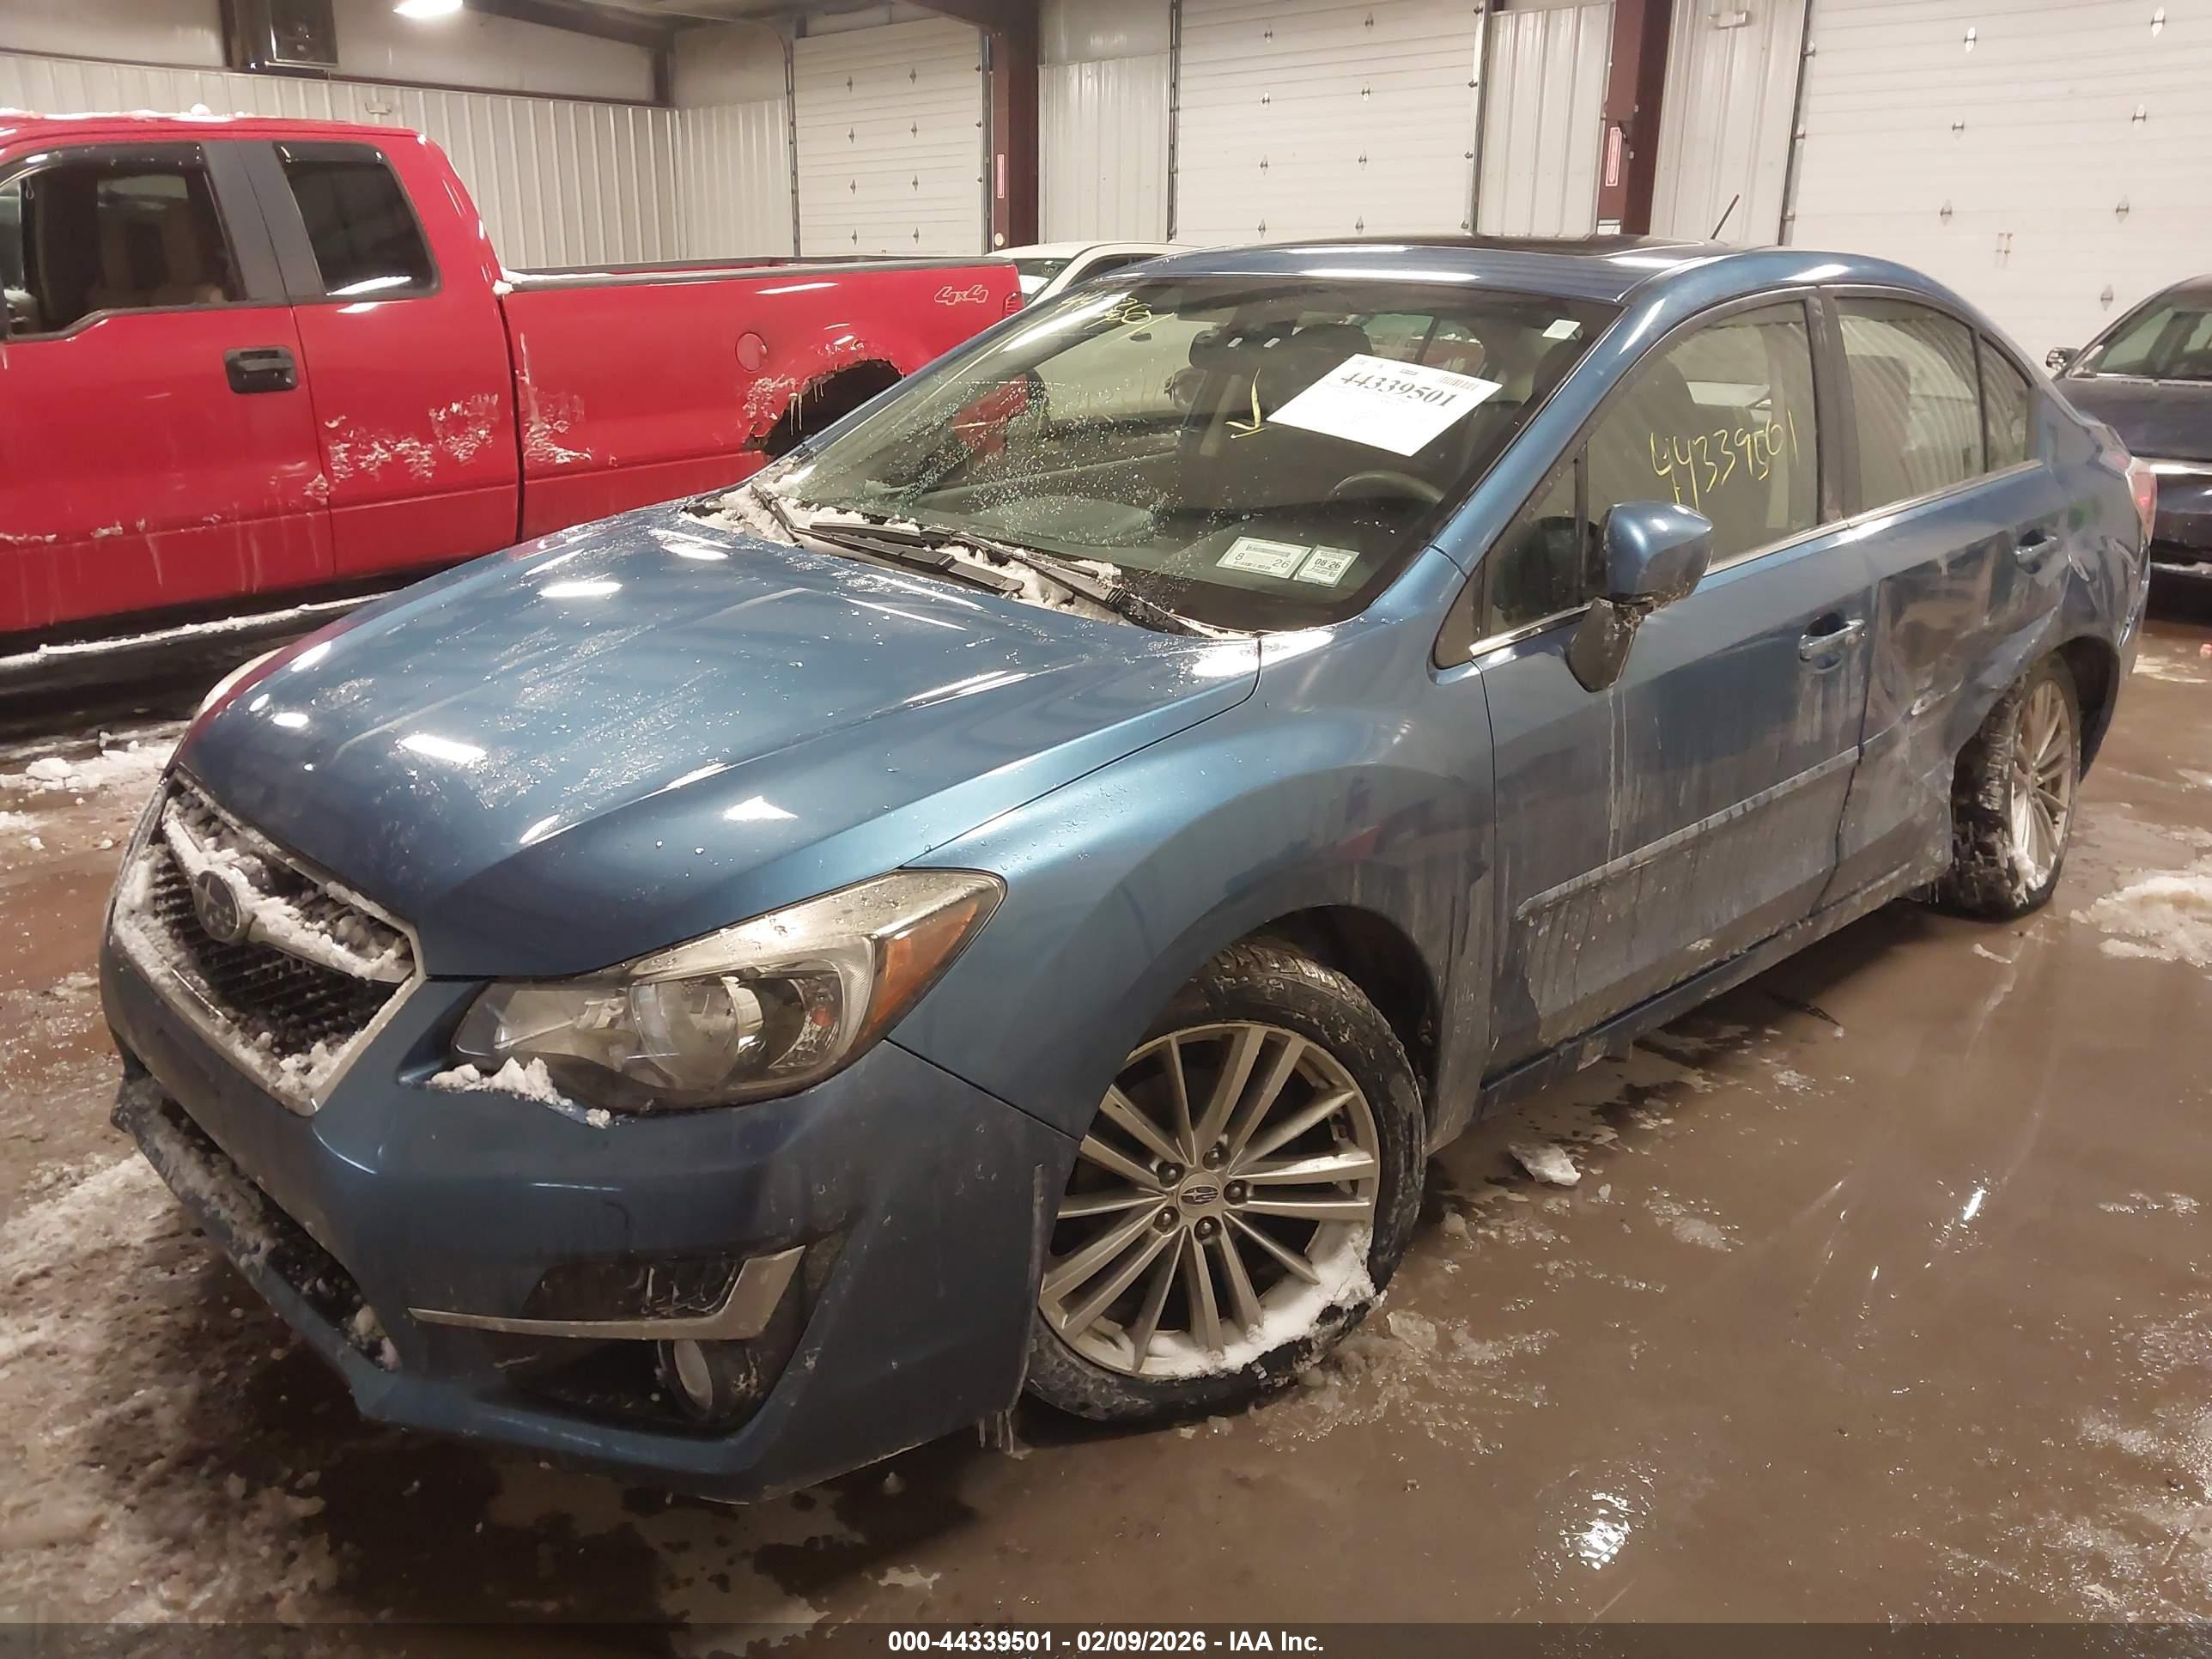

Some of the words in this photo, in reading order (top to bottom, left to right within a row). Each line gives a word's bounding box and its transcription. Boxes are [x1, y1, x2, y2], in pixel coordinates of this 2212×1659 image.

[934, 284, 989, 306] 4x4
[1340, 371, 1458, 408] 44339501
[1650, 409, 1800, 511] 44339501
[1272, 559, 1291, 569] 26
